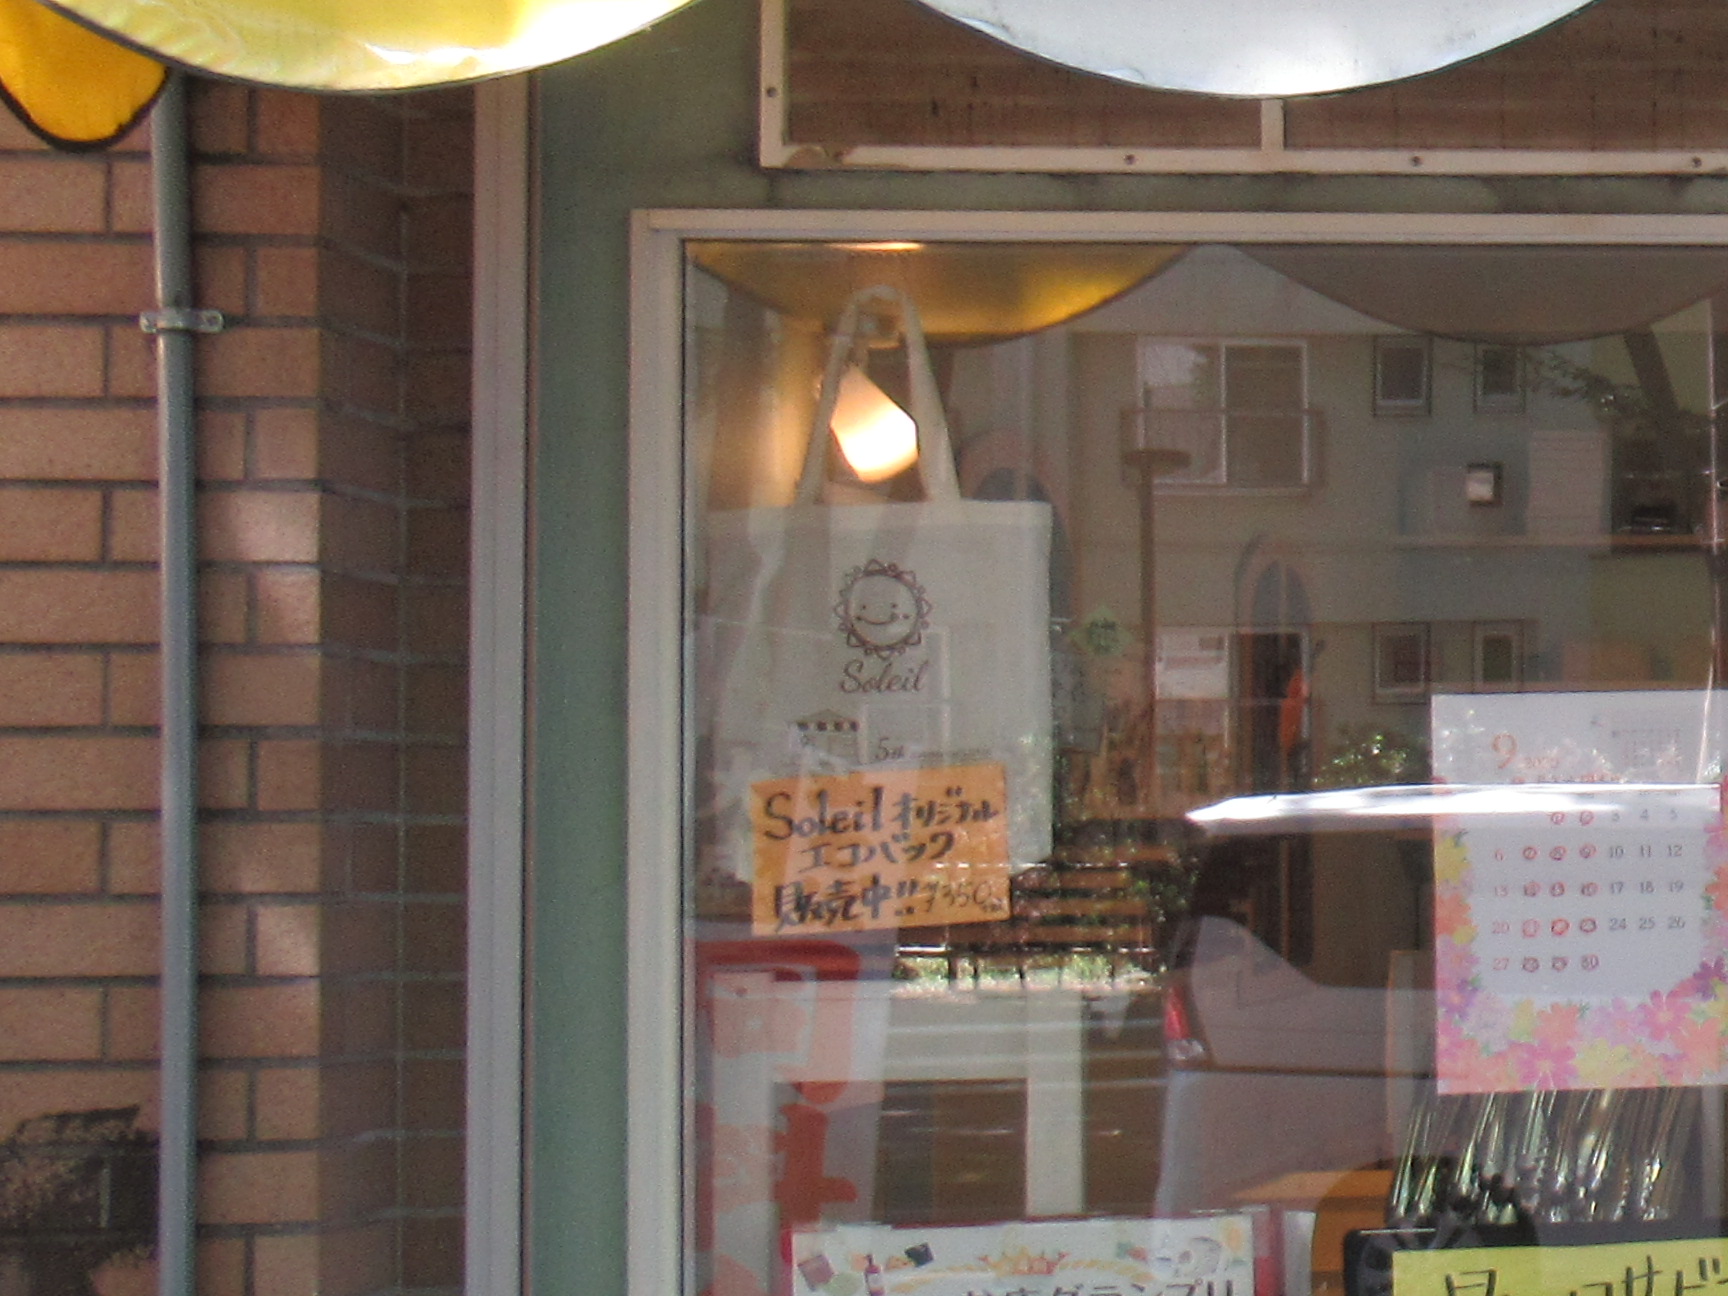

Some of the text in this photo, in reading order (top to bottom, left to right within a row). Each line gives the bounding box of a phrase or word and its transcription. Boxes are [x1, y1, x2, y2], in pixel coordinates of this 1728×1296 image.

[840, 659, 929, 694] Soleil
[1492, 733, 1517, 770] 9
[1609, 845, 1624, 859] 10
[1640, 845, 1652, 858] 11
[1667, 844, 1683, 858] 12
[1610, 882, 1625, 895] 17
[1609, 918, 1627, 931] 24
[1639, 917, 1656, 930] 25
